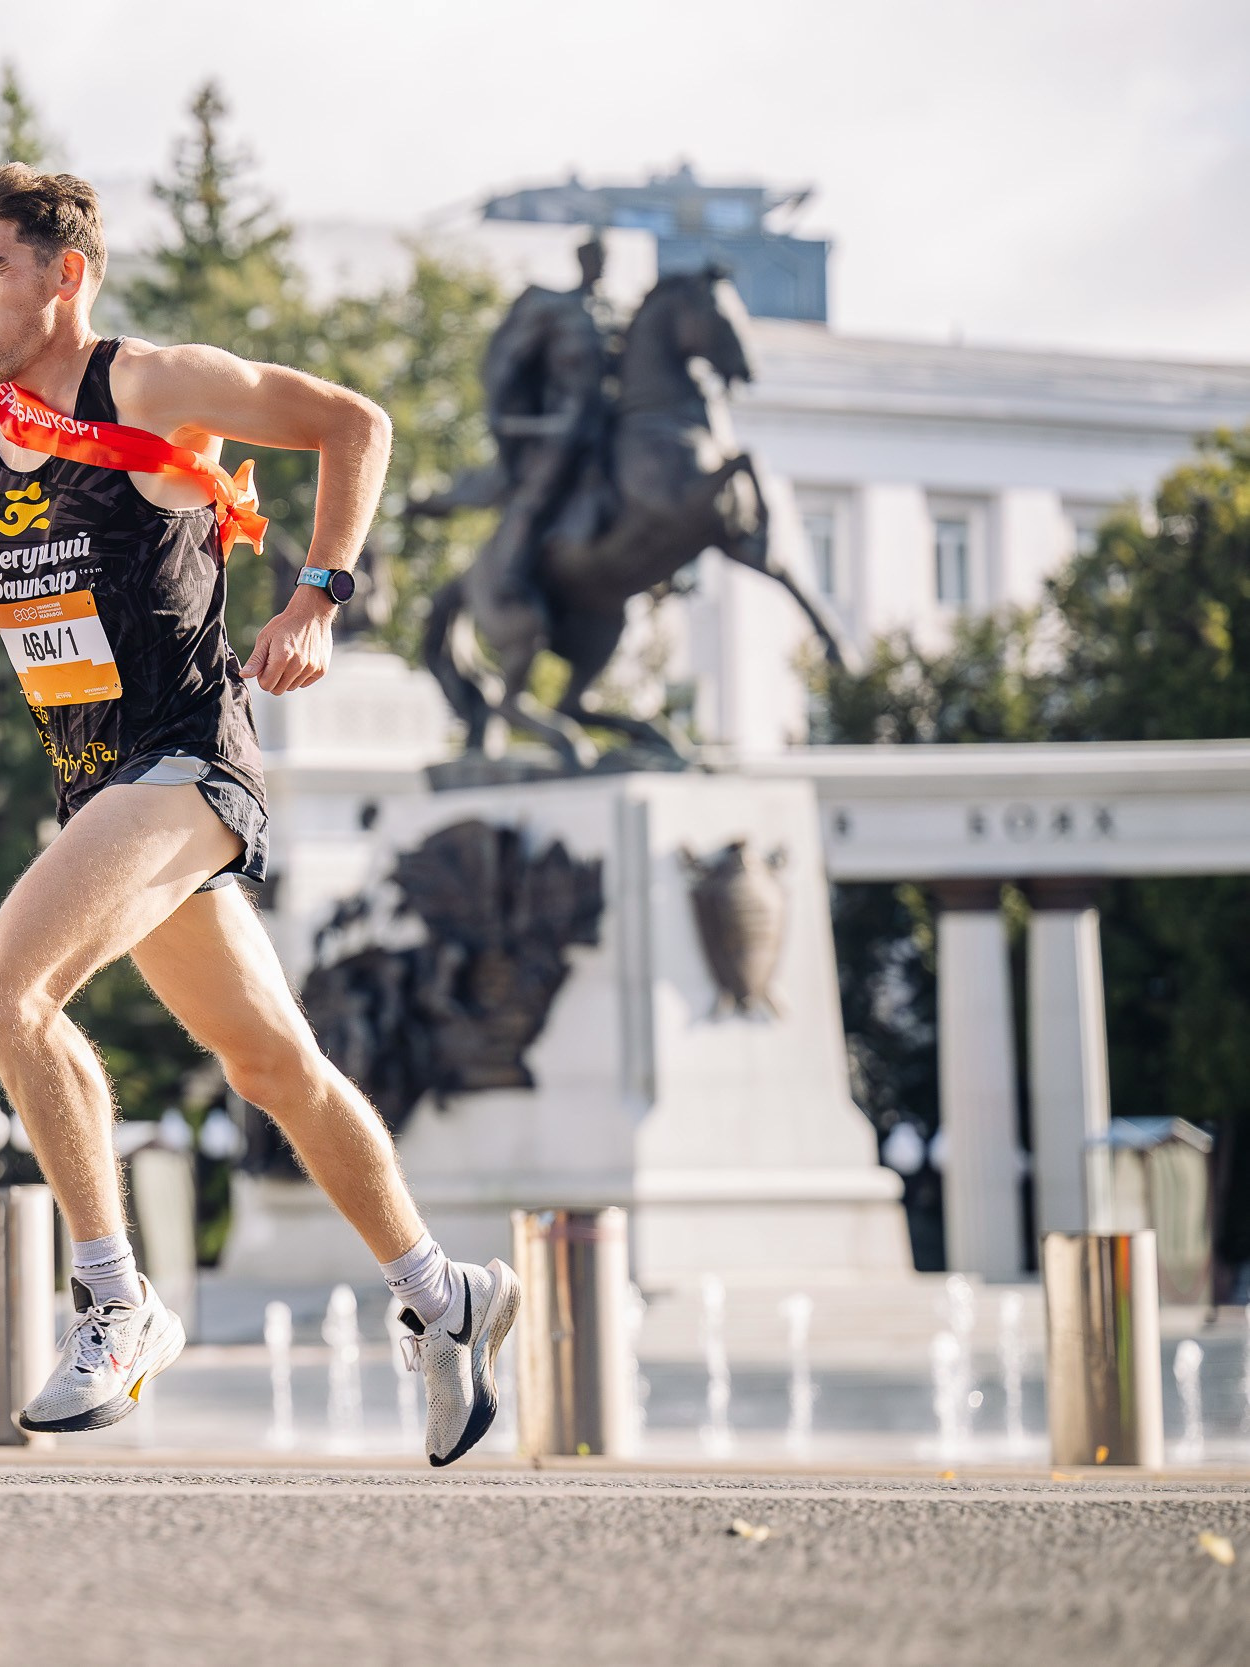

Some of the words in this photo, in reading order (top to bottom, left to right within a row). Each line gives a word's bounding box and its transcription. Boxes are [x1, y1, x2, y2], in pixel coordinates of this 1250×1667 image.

[80, 567, 103, 575] team
[39, 611, 64, 619] МАРАФОН
[22, 626, 80, 662] 464/1
